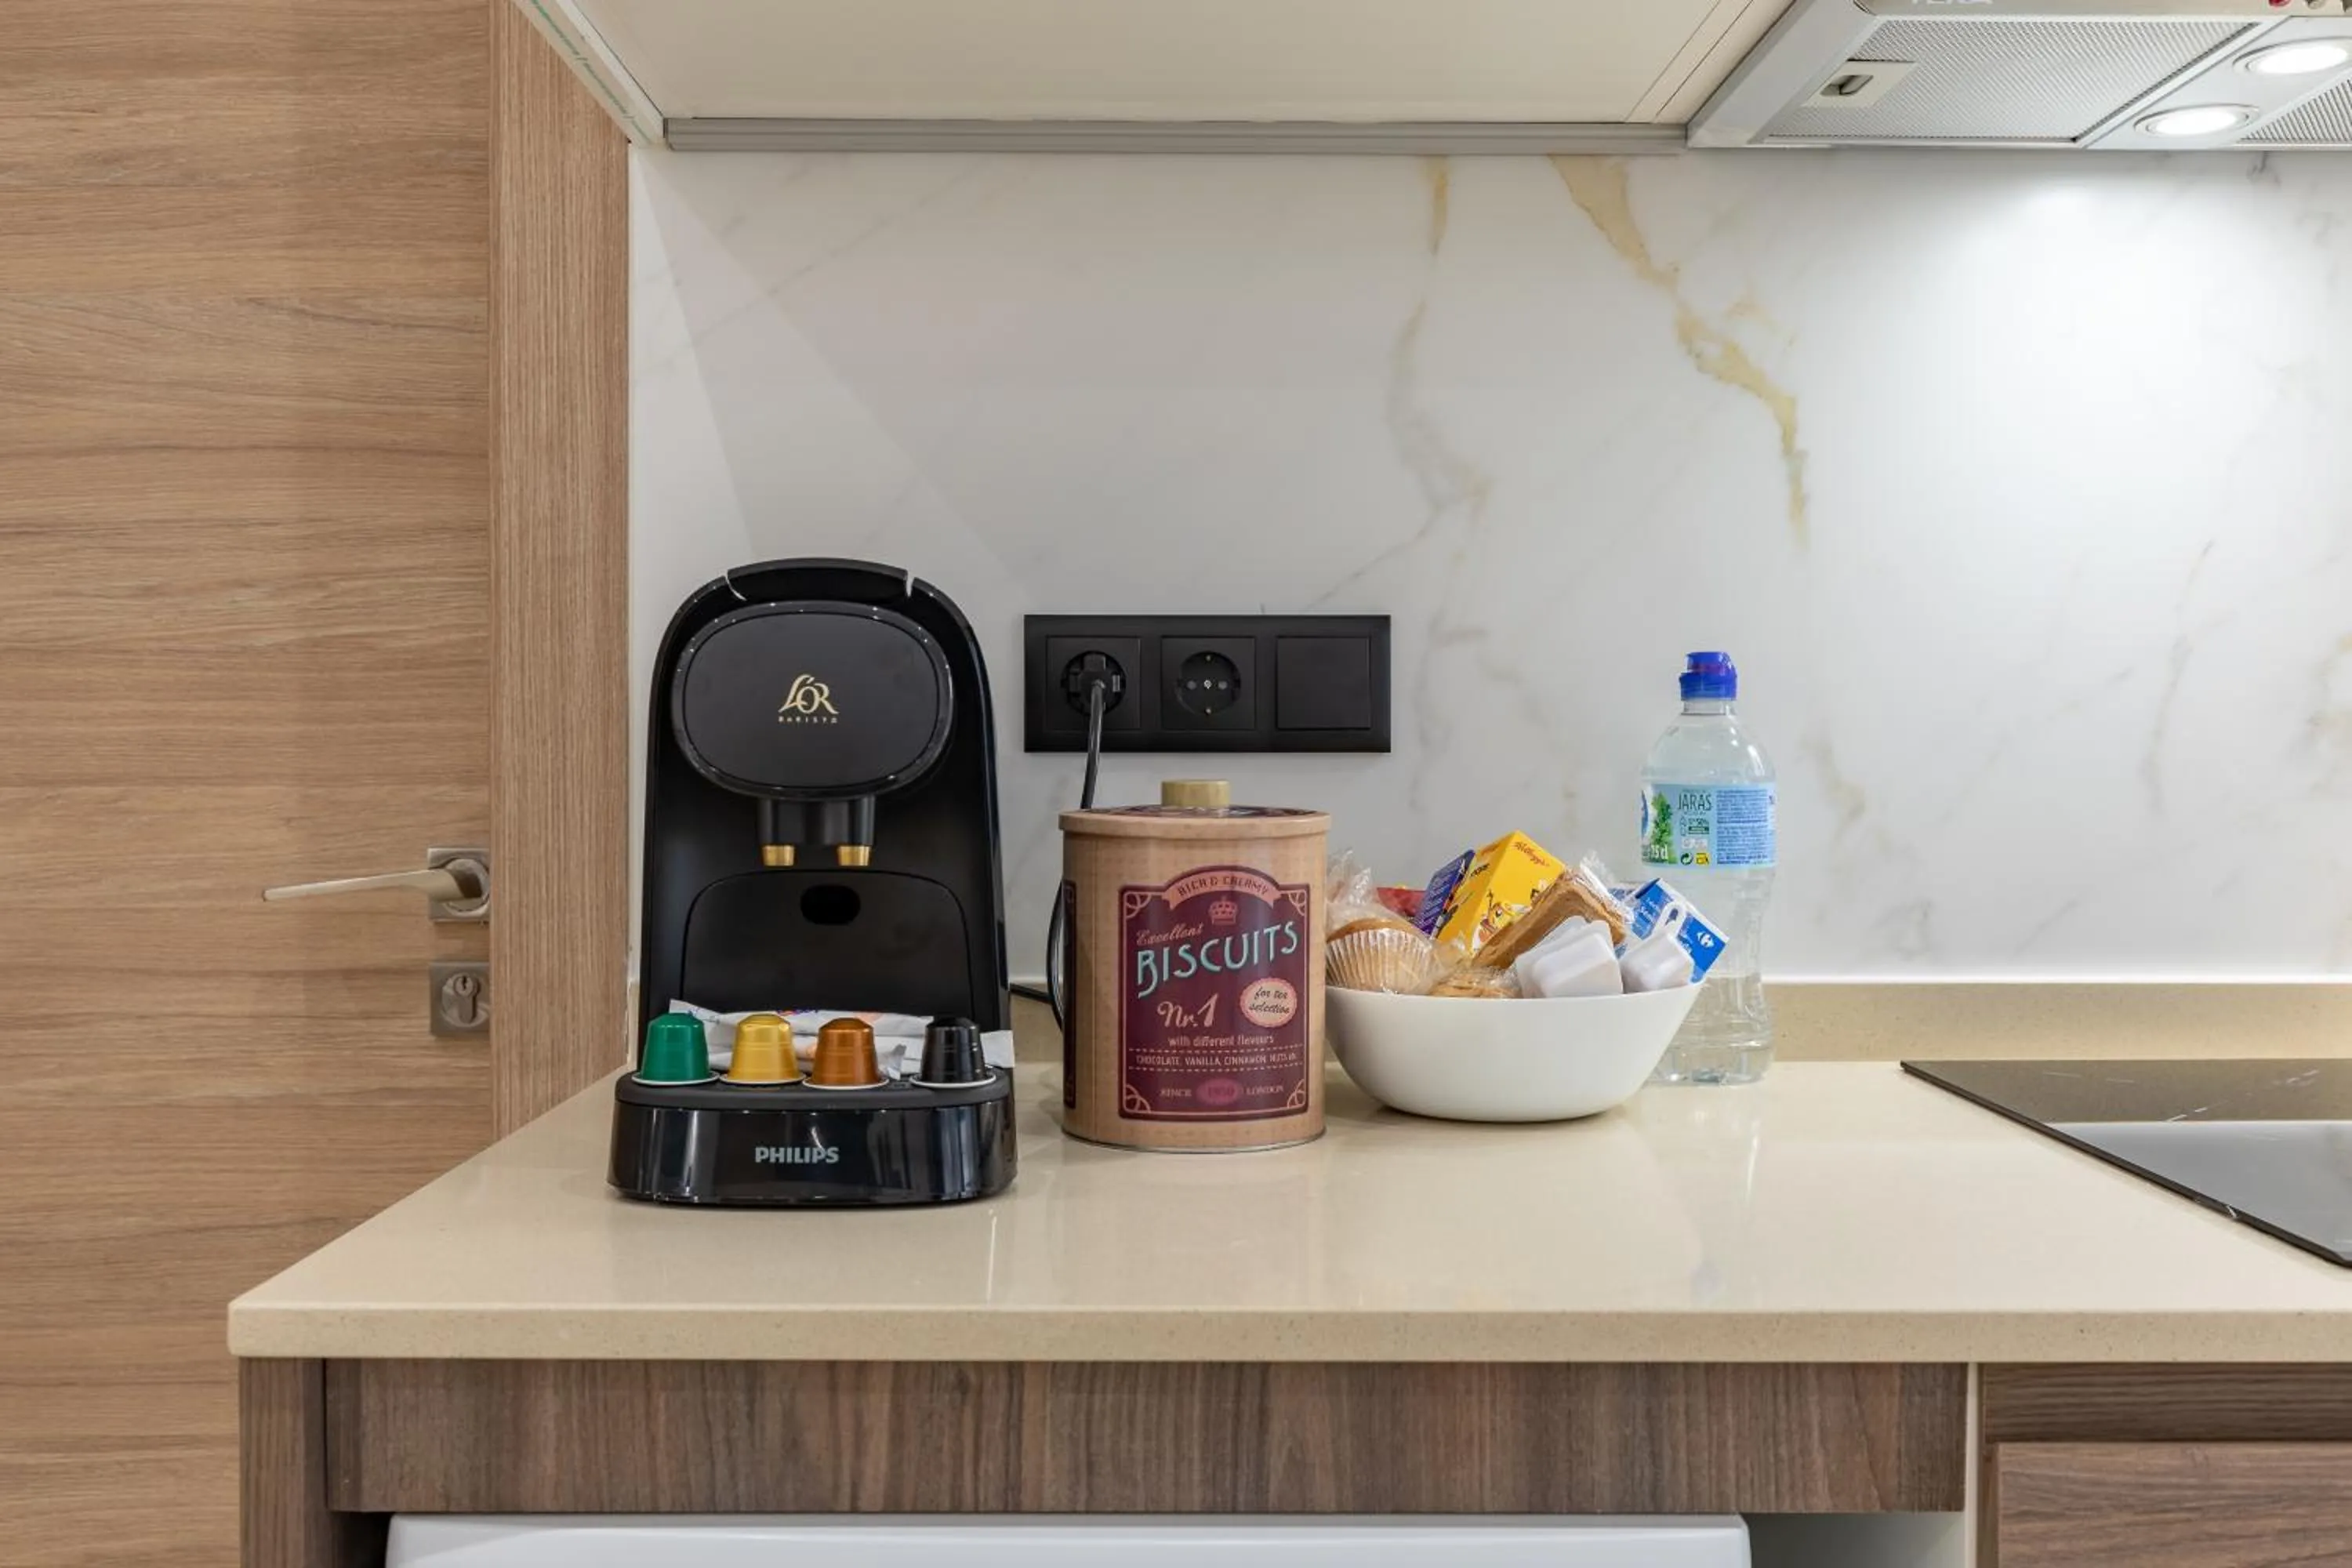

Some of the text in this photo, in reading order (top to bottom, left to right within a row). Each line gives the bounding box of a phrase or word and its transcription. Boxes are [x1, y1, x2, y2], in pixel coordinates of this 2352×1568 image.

[1137, 920, 1298, 998] BISCUITS
[1167, 1036, 1191, 1047] with
[1192, 1034, 1235, 1047] different
[755, 1146, 840, 1163] PHILIPS
